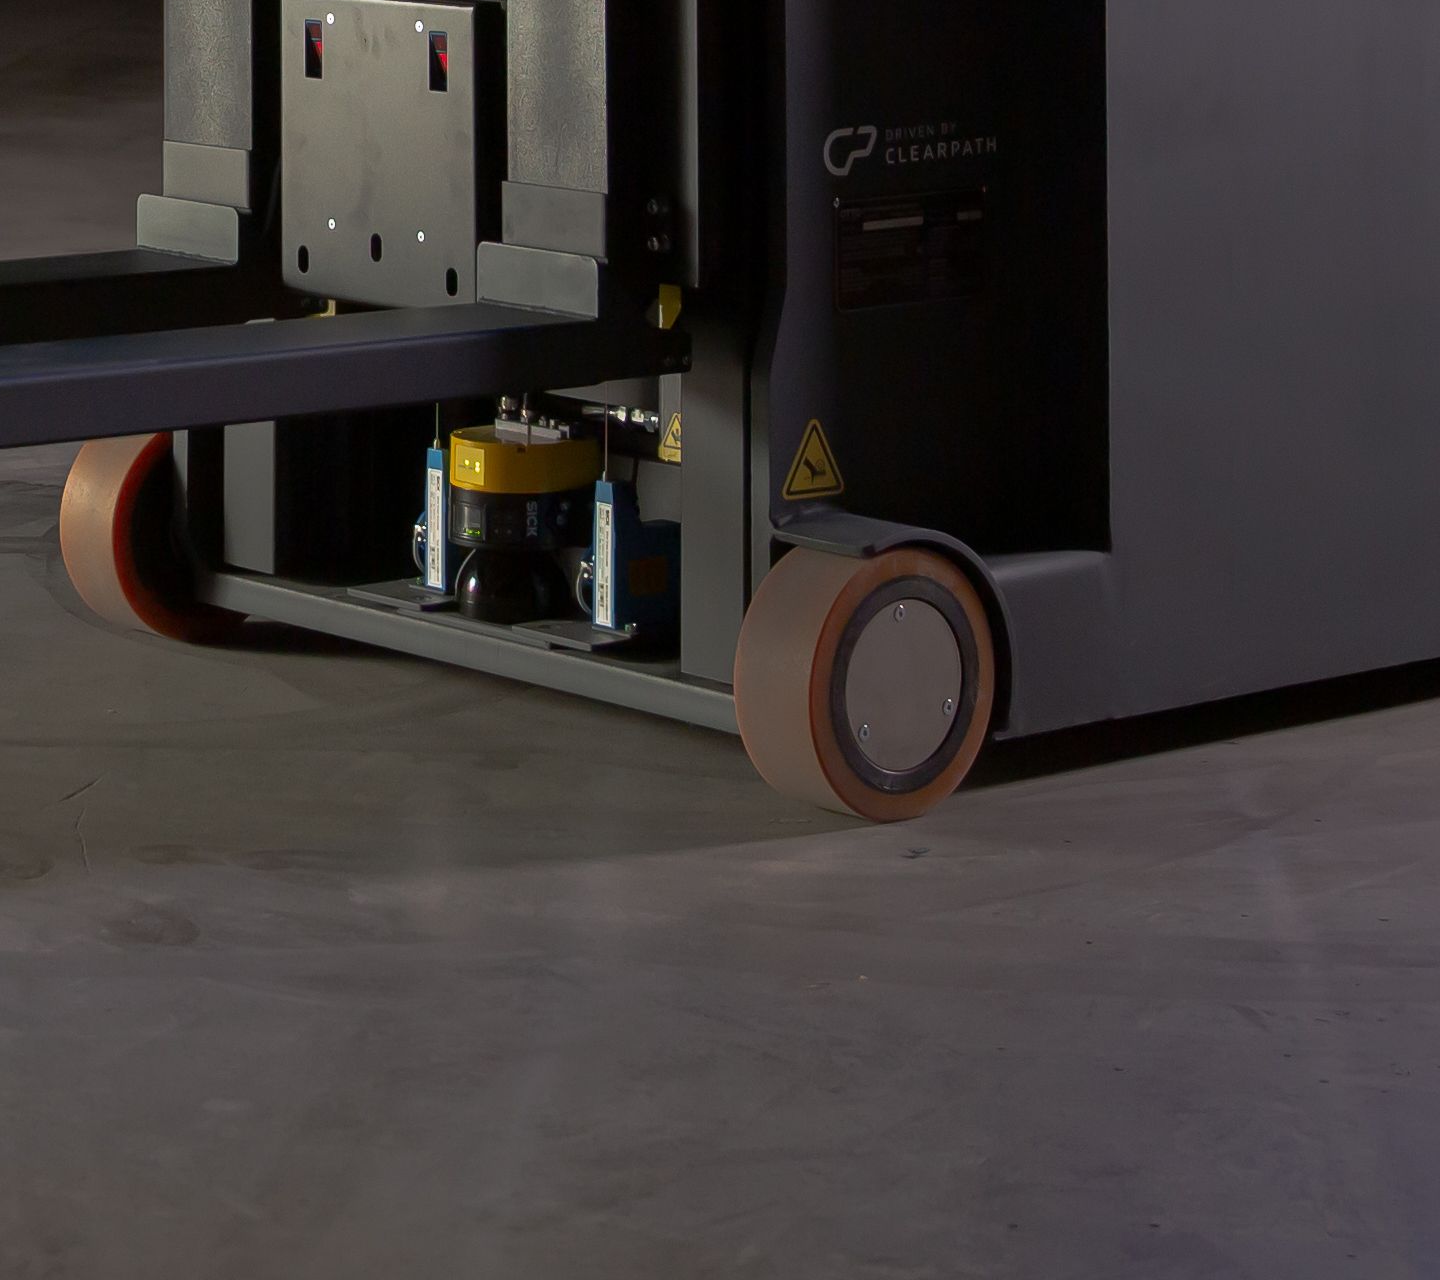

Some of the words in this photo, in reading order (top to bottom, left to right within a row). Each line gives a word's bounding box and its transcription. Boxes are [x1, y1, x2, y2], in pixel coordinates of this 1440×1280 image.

[885, 125, 935, 141] DRIVEN
[941, 122, 957, 136] BY
[885, 136, 998, 165] CLEARPATH
[526, 501, 538, 536] SICK
